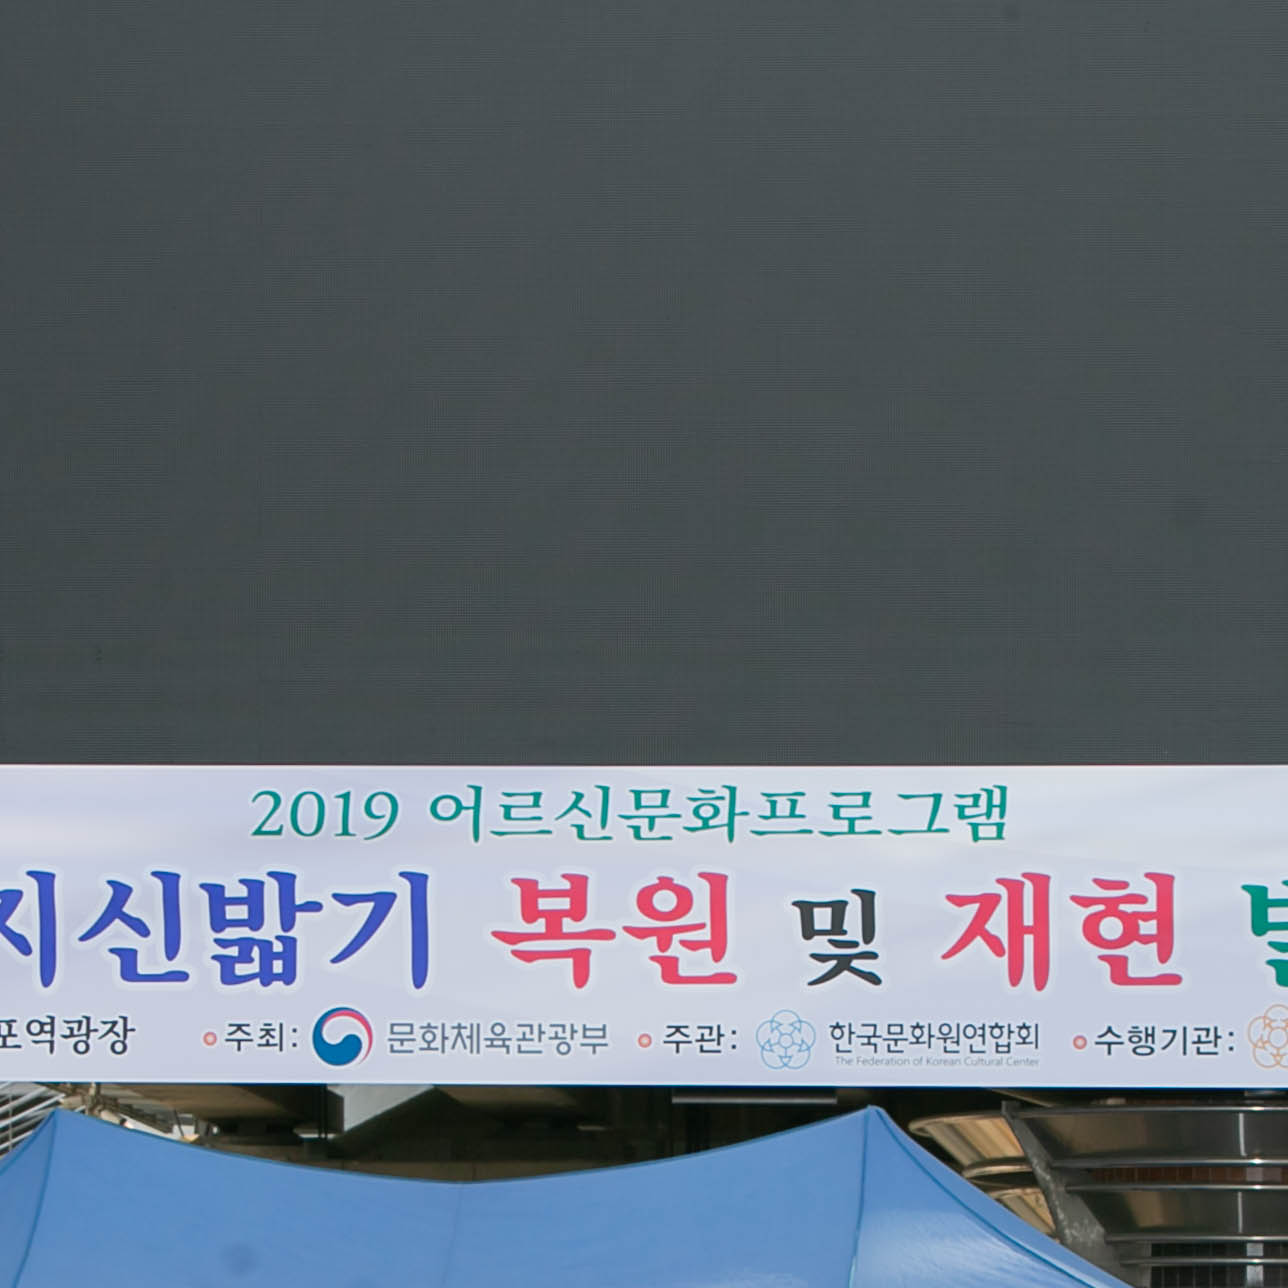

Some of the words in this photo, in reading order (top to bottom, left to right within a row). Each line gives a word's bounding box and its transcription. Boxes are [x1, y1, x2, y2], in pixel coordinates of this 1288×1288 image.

[251, 789, 400, 841] 2019
[428, 783, 1008, 844] 어르신문화프로그램
[490, 871, 738, 990] 복원
[791, 887, 883, 987] 및
[940, 871, 1183, 993] 재현
[224, 1021, 298, 1053] 주최:
[387, 1021, 609, 1056] 문화체육관광부
[663, 1022, 737, 1055] 주관:
[828, 1021, 1039, 1054] 한국문화원연합회
[1094, 1024, 1235, 1057] 수행기관:
[856, 1055, 911, 1067] Federation
[925, 1055, 962, 1067] Korean
[963, 1055, 1004, 1067] Cultural
[1005, 1055, 1040, 1067] Center
